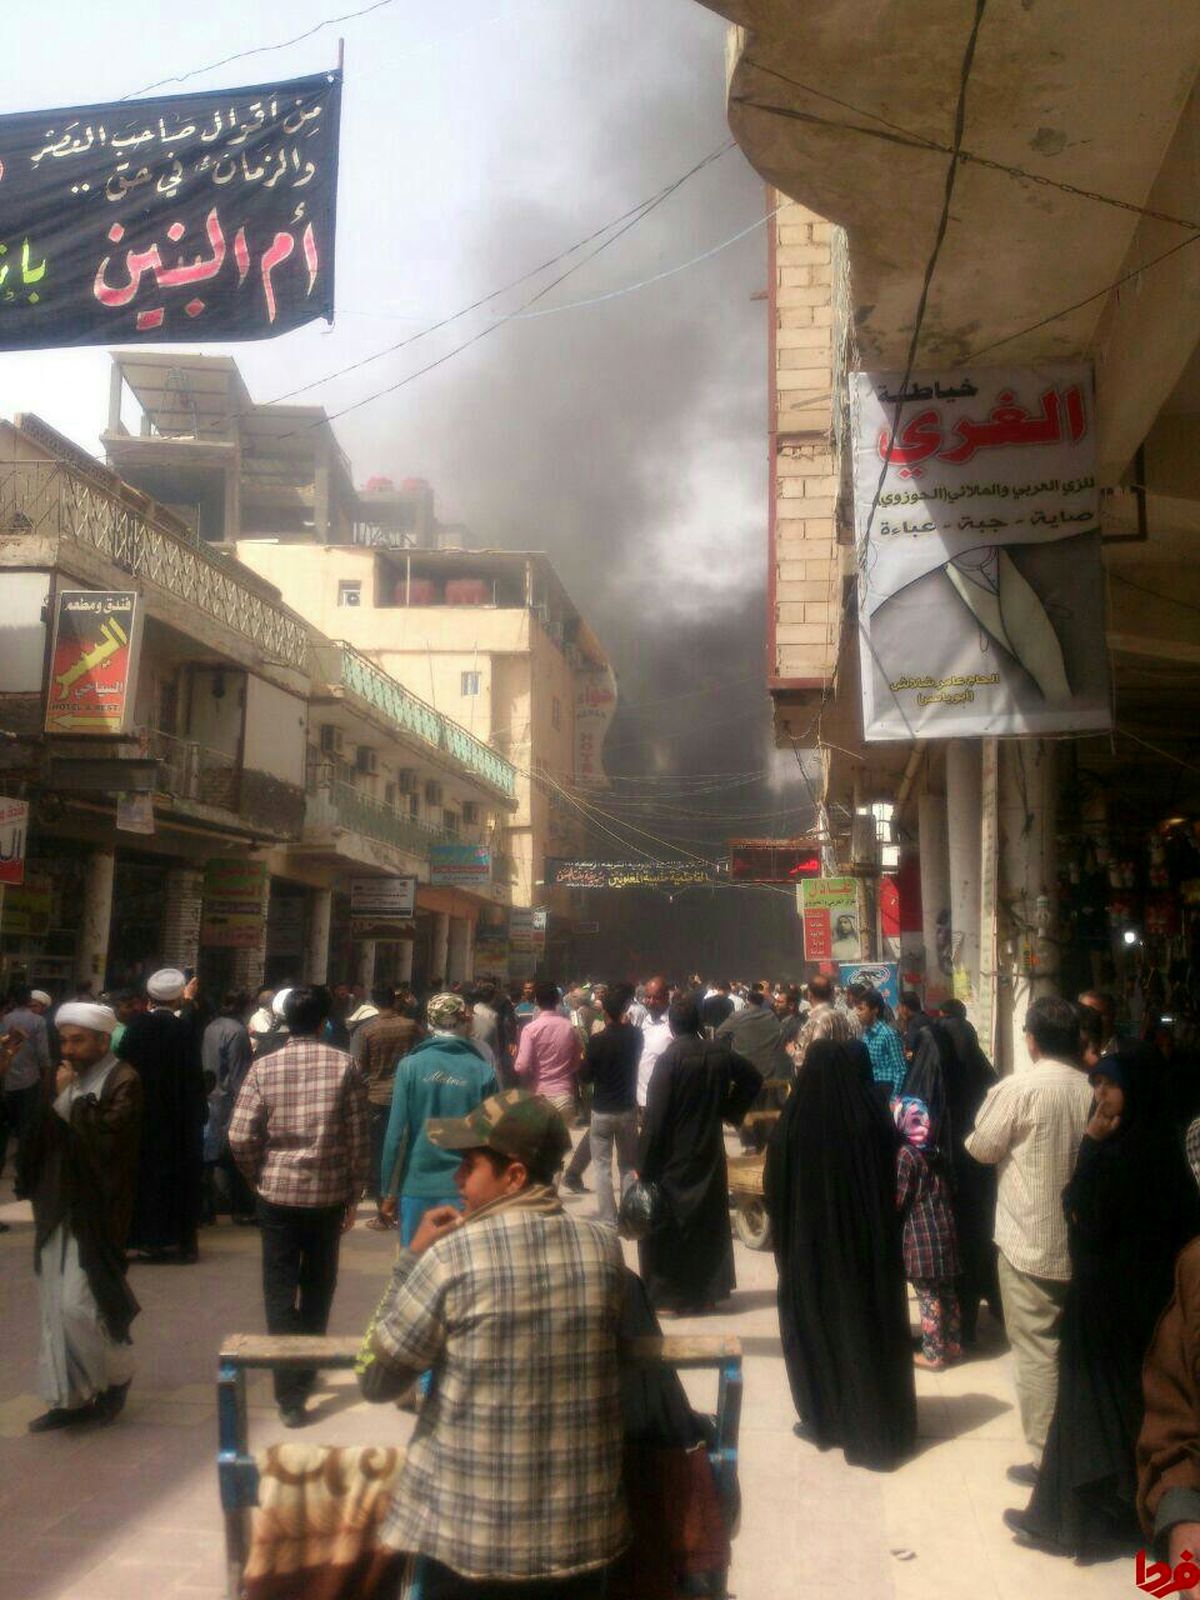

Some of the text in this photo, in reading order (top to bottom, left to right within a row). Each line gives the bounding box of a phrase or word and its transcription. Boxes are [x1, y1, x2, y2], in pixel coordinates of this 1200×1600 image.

[283, 99, 322, 137] من
[157, 151, 183, 198] في
[93, 206, 250, 331] البنين
[877, 378, 979, 403] خياطة
[878, 386, 1086, 479] الغري
[103, 596, 131, 614] فندق
